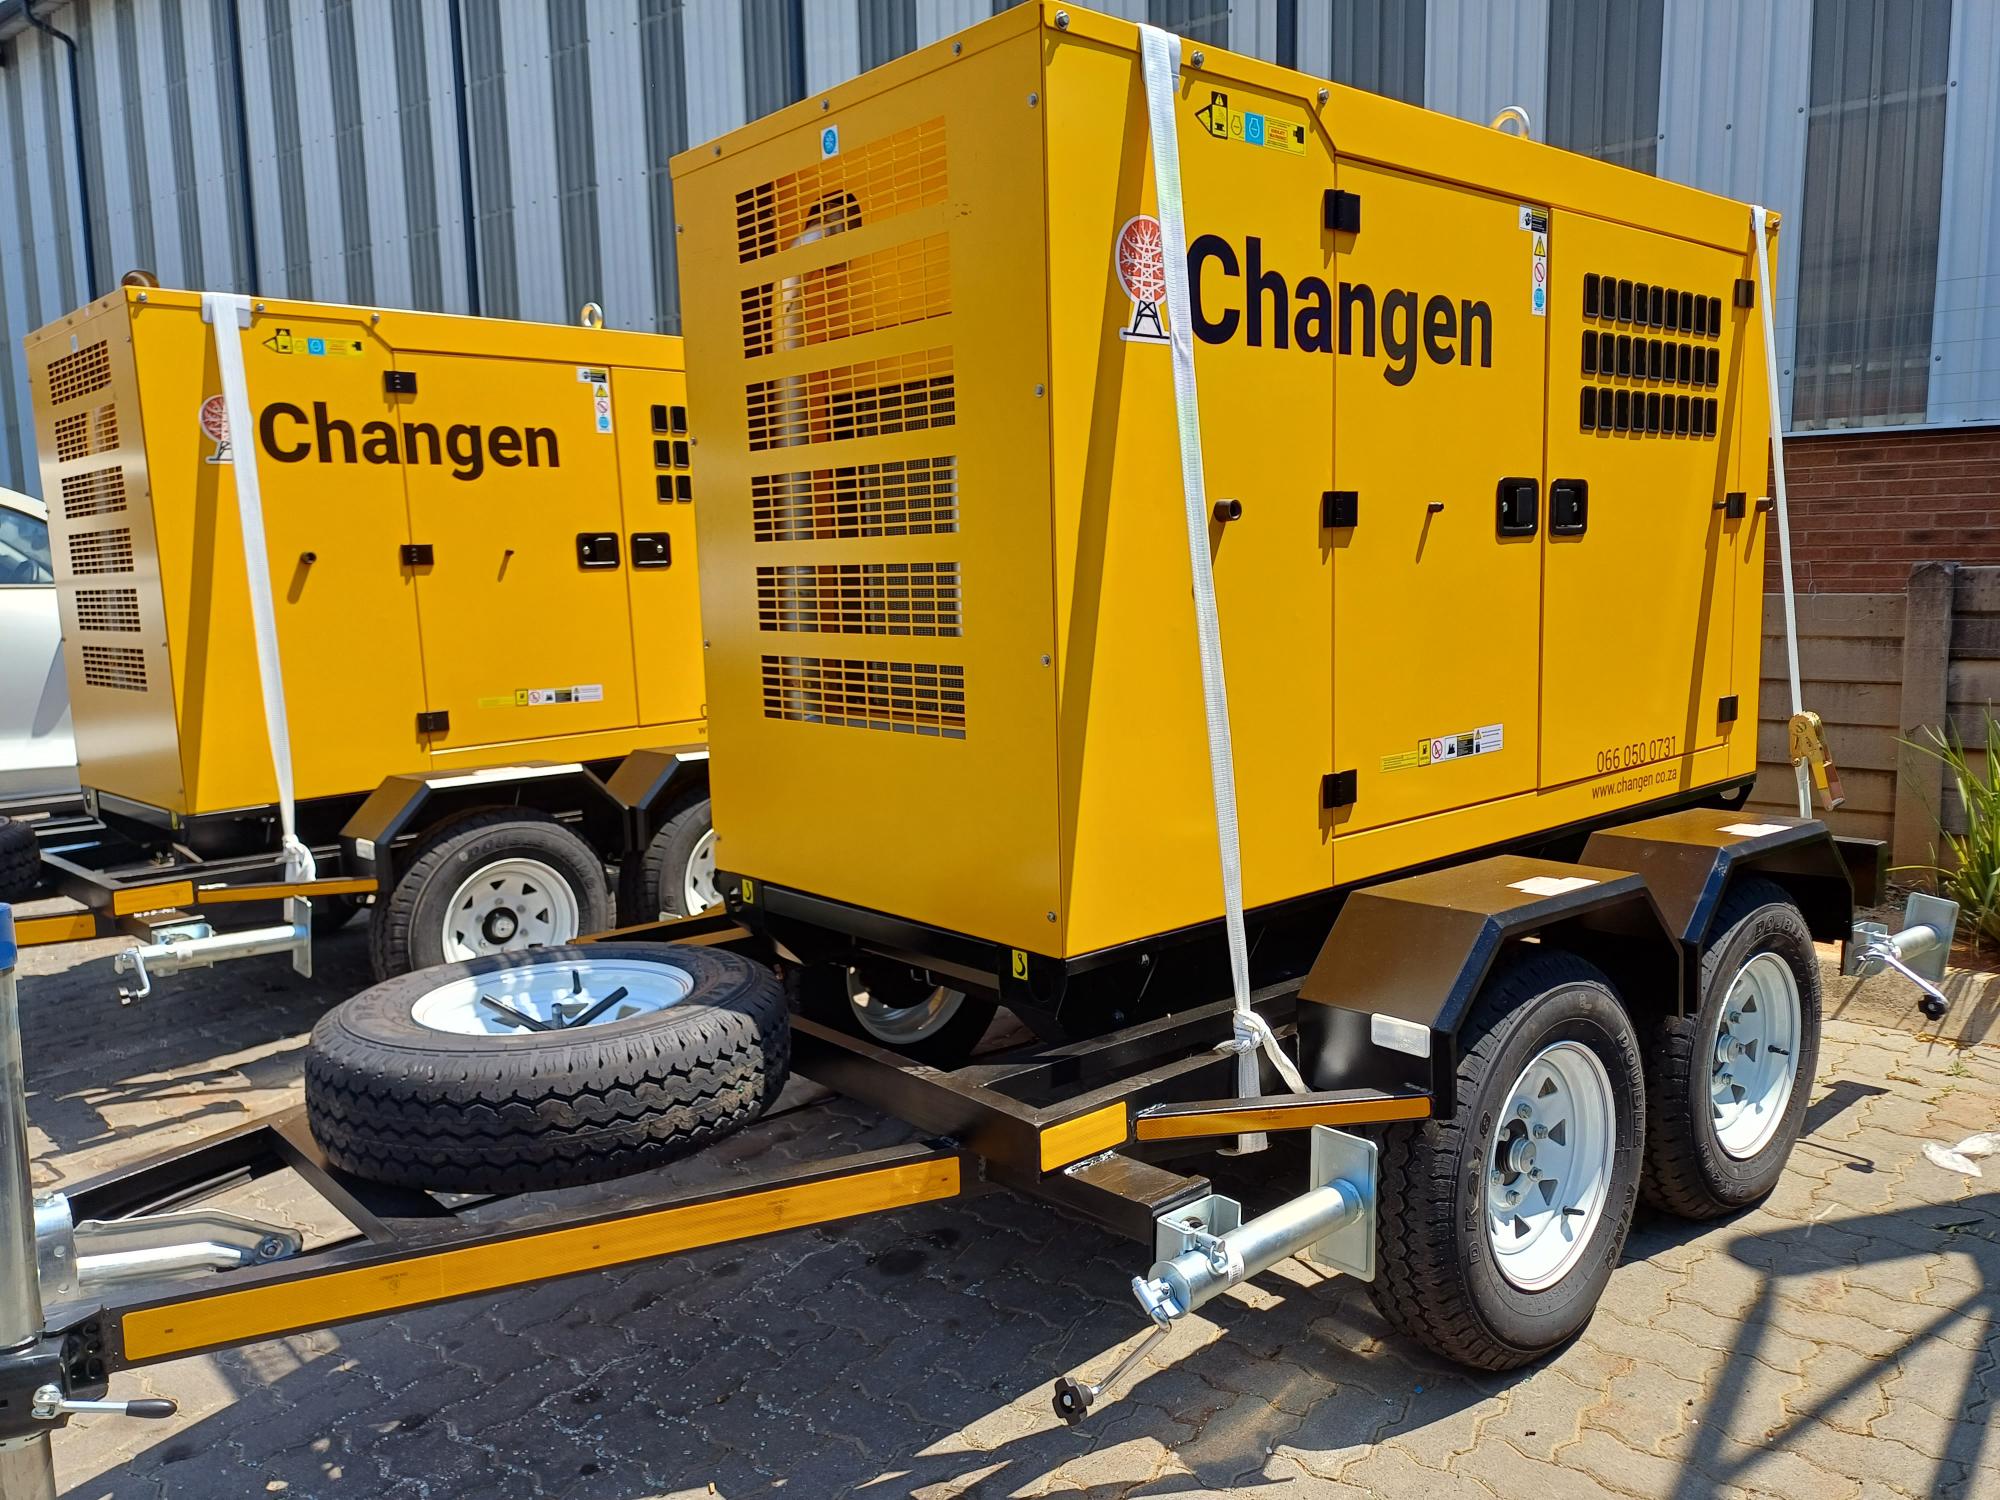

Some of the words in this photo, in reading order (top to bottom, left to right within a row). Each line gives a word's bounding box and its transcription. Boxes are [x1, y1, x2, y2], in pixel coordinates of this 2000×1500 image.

[1187, 234, 1492, 387] Changen
[259, 401, 560, 481] Changen
[1596, 747, 1620, 773] 066
[1623, 742, 1646, 767] 050
[1649, 735, 1676, 761] 0731
[1754, 915, 1805, 941] DOUBLE
[1617, 1029, 1645, 1148] DOUBLE
